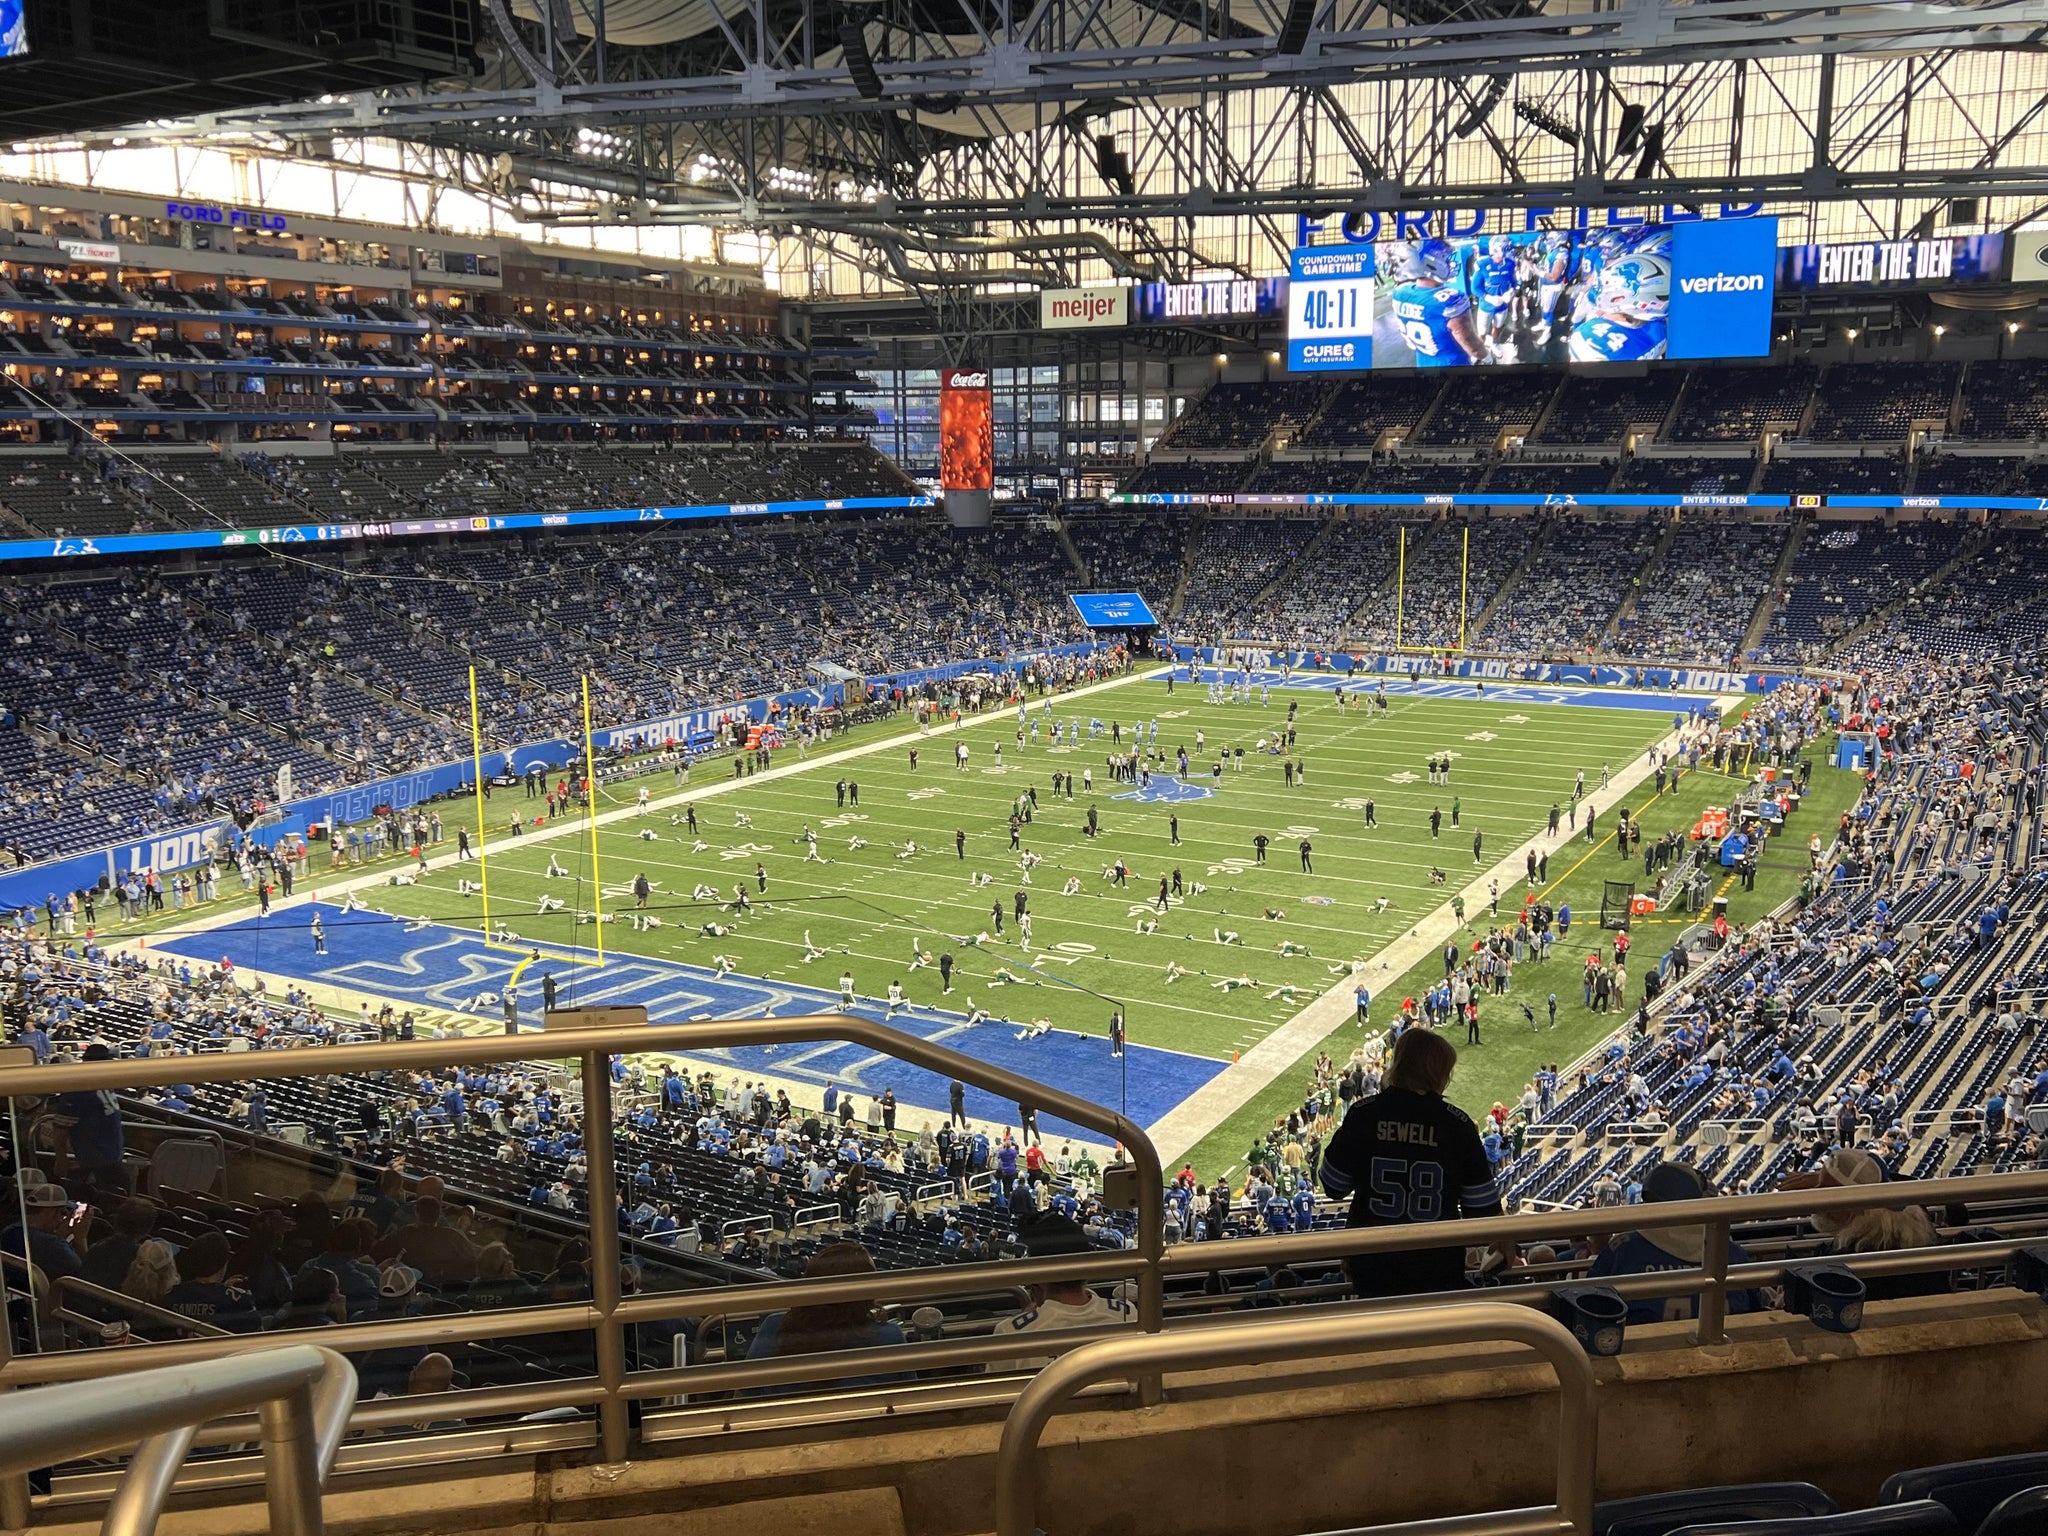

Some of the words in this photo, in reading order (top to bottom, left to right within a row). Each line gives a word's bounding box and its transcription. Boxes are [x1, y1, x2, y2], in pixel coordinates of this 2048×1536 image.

[166, 203, 223, 222] FORD
[231, 210, 287, 230] FIELD
[1299, 254, 1355, 265] COUNTDOWN
[1355, 253, 1367, 262] TO
[1819, 245, 1874, 284] ENTER
[1880, 242, 1912, 281] THE
[1915, 239, 1953, 278] DEN
[1303, 261, 1362, 275] GAMETIME
[1680, 272, 1764, 294] verizon
[1165, 284, 1202, 316] ENTER
[1206, 282, 1230, 314] THE
[1232, 281, 1257, 313] DEN
[1052, 292, 1116, 321] meijer
[1303, 288, 1358, 329] 40:11
[1591, 322, 1629, 352] 44
[825, 501, 843, 509] verizon
[1210, 495, 1232, 503] 40:11
[1424, 495, 1453, 504] verizon
[1683, 496, 1710, 504] ENTER
[1711, 496, 1727, 504] THE
[1729, 496, 1747, 505] DEN
[1801, 496, 1815, 505] 40
[1903, 497, 1939, 507] verizon
[747, 505, 757, 513] THE
[758, 504, 768, 512] DEN
[473, 519, 486, 529] 40
[542, 515, 568, 525] verizon
[259, 530, 268, 543] 0
[318, 527, 326, 539] 0
[362, 524, 391, 536] 40:11
[1670, 669, 1749, 692] LIONS
[610, 719, 690, 748] DETROIT
[329, 772, 434, 823] DETROIT
[130, 825, 220, 876] LIONS
[720, 842, 774, 861] 20
[1207, 857, 1258, 876] 30
[1127, 896, 1184, 918] 20
[1637, 902, 1645, 910] G
[1031, 942, 1097, 968] 10
[1377, 1121, 1438, 1147] SEWELL
[1284, 1181, 1291, 1191] 5
[1369, 1156, 1444, 1222] 58
[1273, 1207, 1284, 1215] 22
[172, 1303, 216, 1316] SANDERS
